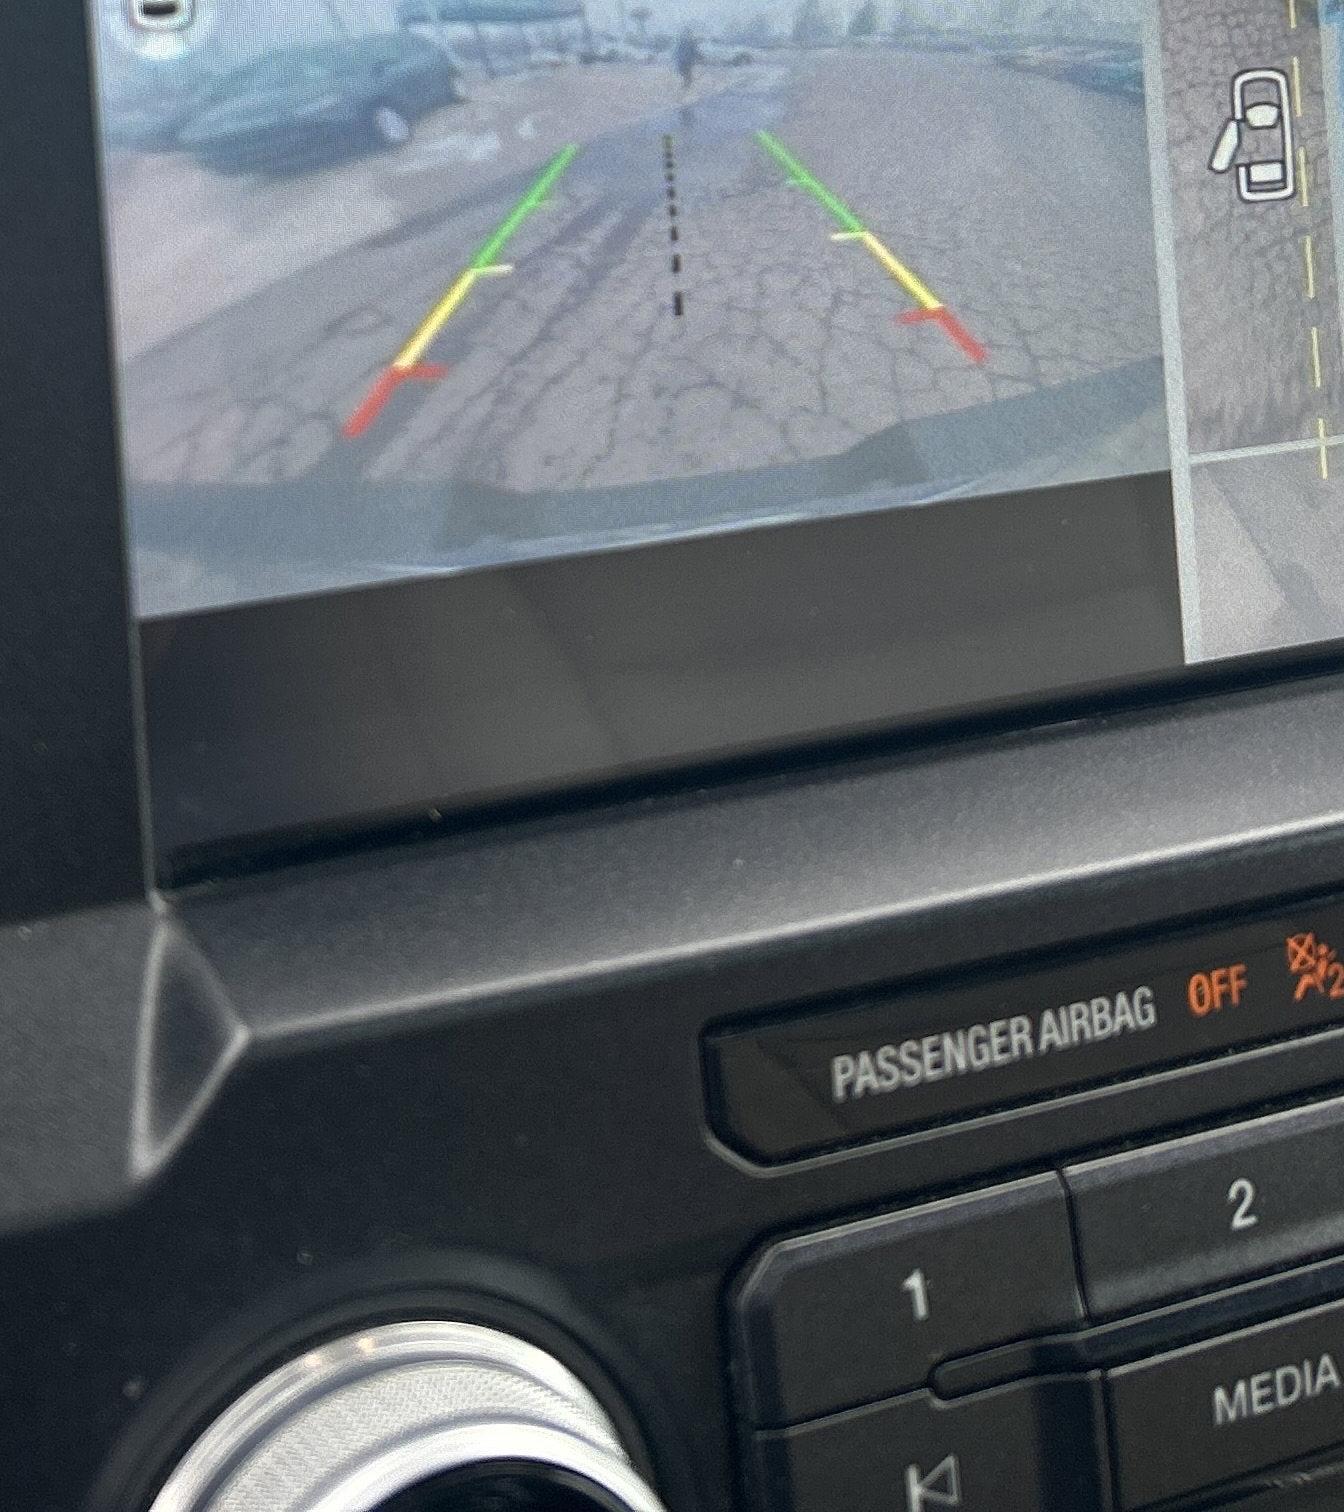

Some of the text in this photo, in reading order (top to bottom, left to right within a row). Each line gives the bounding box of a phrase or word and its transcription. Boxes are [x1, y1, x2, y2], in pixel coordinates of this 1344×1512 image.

[830, 1013, 1035, 1103] PASSENGER
[1037, 985, 1157, 1055] AIRBAG
[1187, 961, 1249, 1017] OFF
[1227, 1178, 1258, 1231] 2
[900, 1268, 932, 1322] 1
[1212, 1352, 1342, 1426] MEDIA
